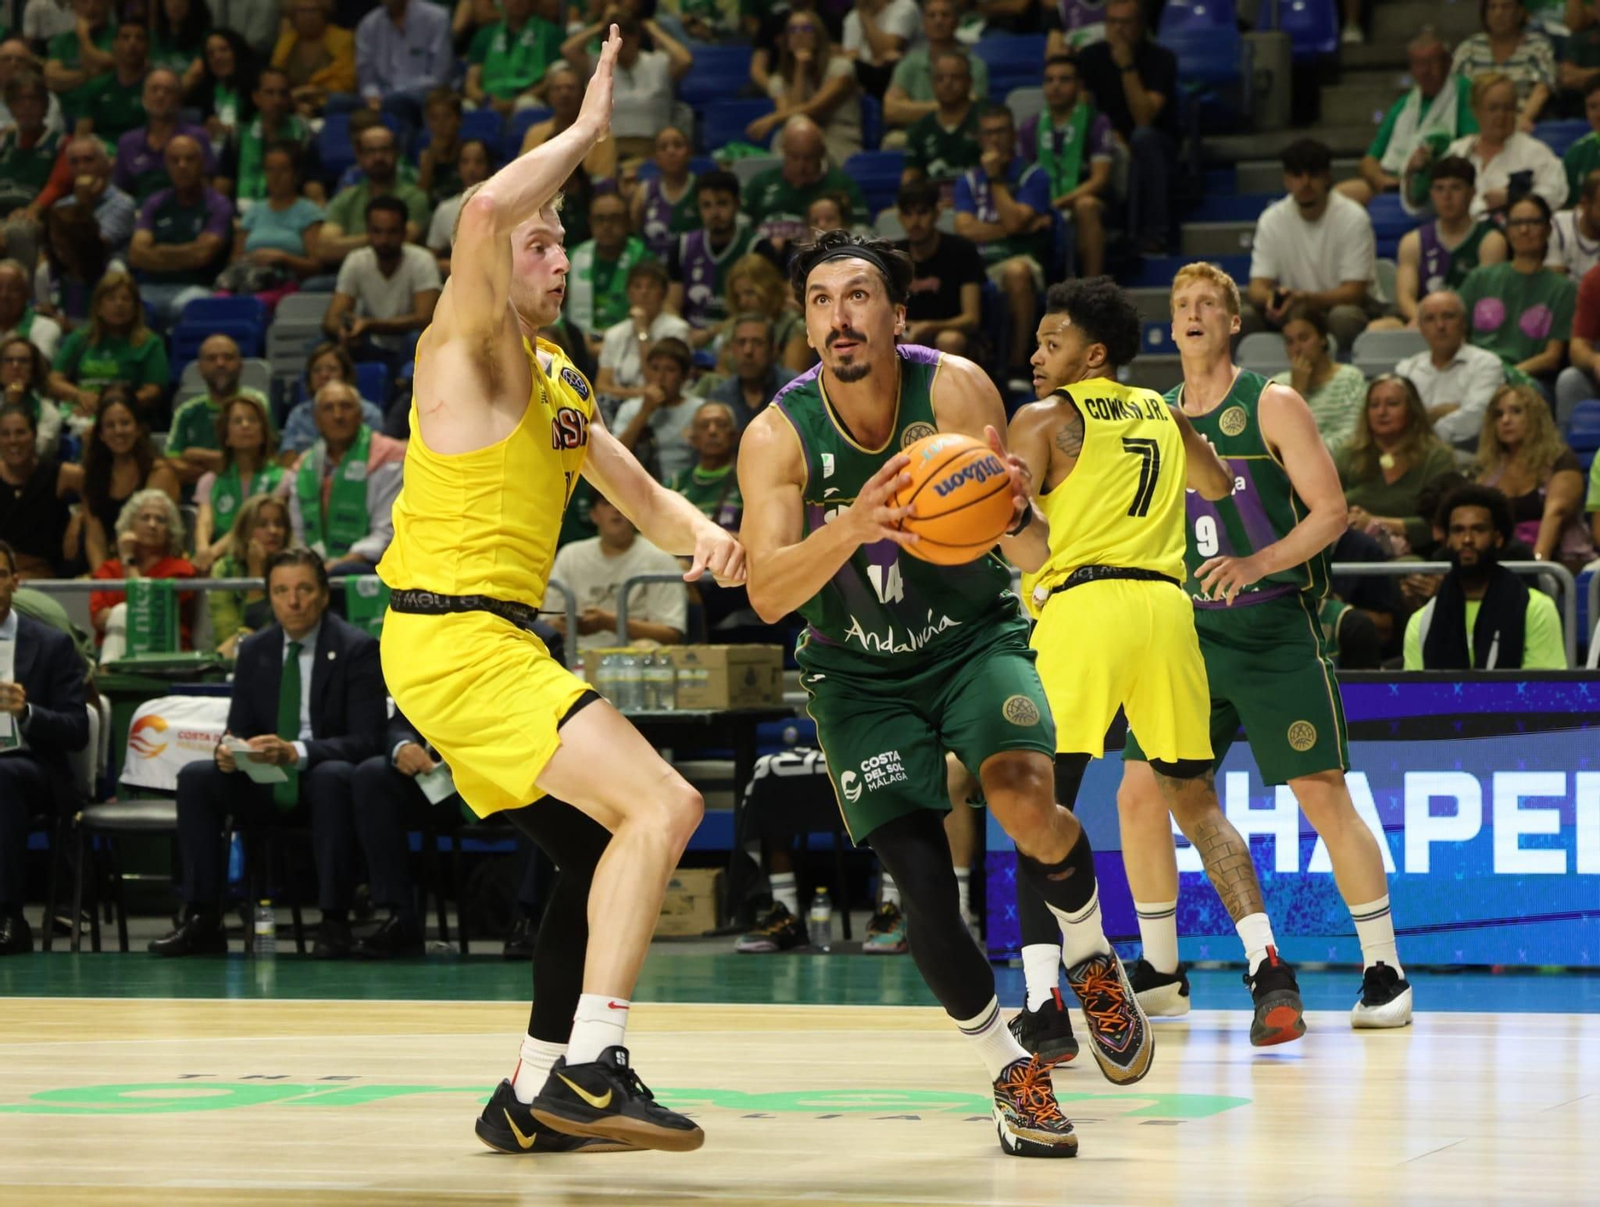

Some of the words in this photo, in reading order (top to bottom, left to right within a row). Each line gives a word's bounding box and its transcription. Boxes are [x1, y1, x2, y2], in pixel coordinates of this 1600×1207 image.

[1143, 399, 1168, 421] JR.
[933, 454, 1005, 497] Wilson
[1121, 436, 1161, 517] 7
[1195, 515, 1219, 557] 9
[866, 556, 904, 604] 14
[843, 608, 963, 655] Andalucía
[860, 750, 902, 772] COSTA
[863, 767, 886, 783] DEL
[886, 762, 905, 773] SOL
